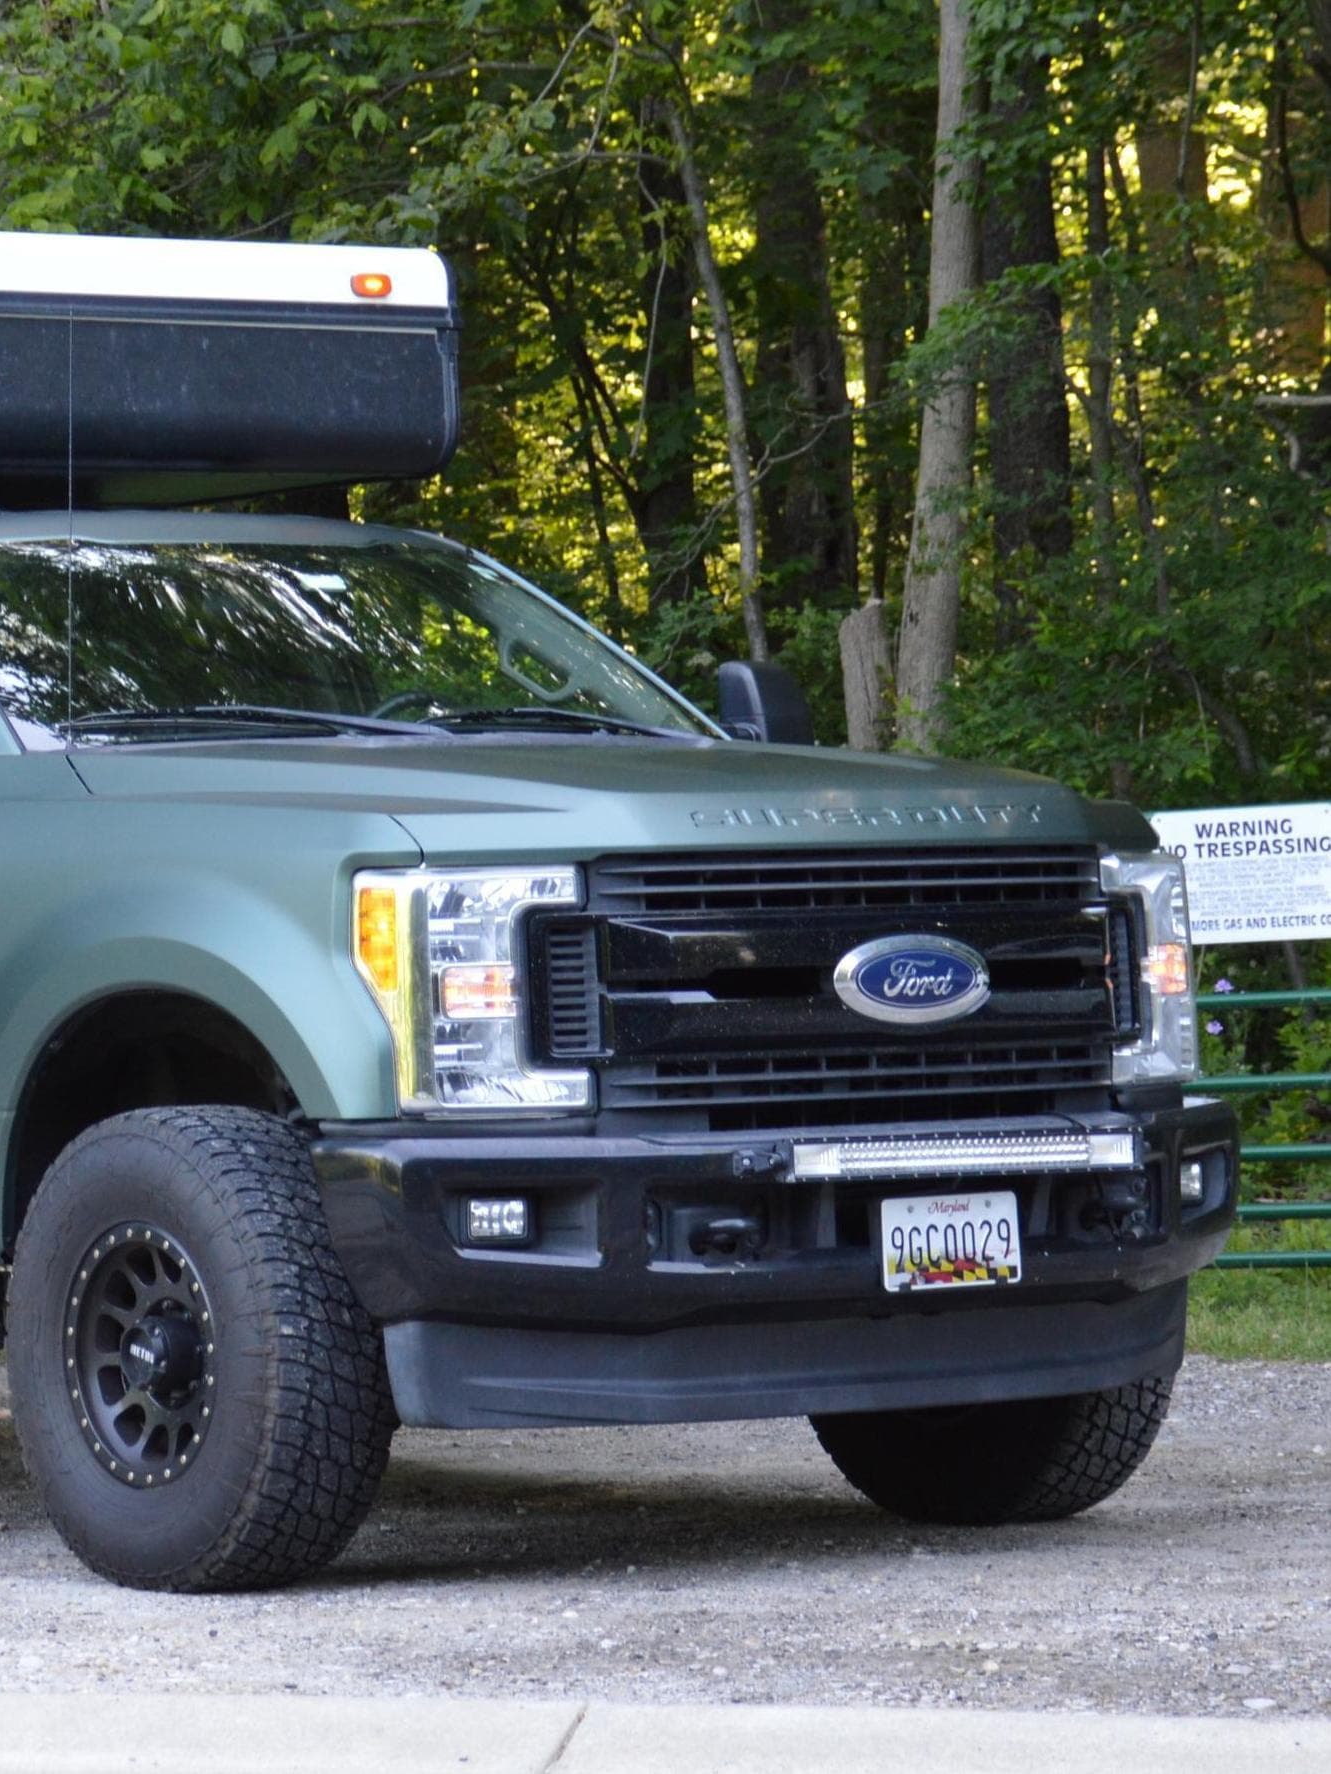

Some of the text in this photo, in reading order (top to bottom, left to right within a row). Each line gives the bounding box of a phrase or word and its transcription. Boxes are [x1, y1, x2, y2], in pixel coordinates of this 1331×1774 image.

[1195, 819, 1293, 838] WARNING
[1194, 837, 1331, 858] TRESPASSING
[1224, 917, 1243, 930] GAS
[1246, 917, 1267, 930] AND
[1271, 915, 1317, 928] ELECTRIC
[883, 958, 954, 997] Ford
[927, 1200, 971, 1217] Maryland
[891, 1218, 1011, 1269] 9GC0029
